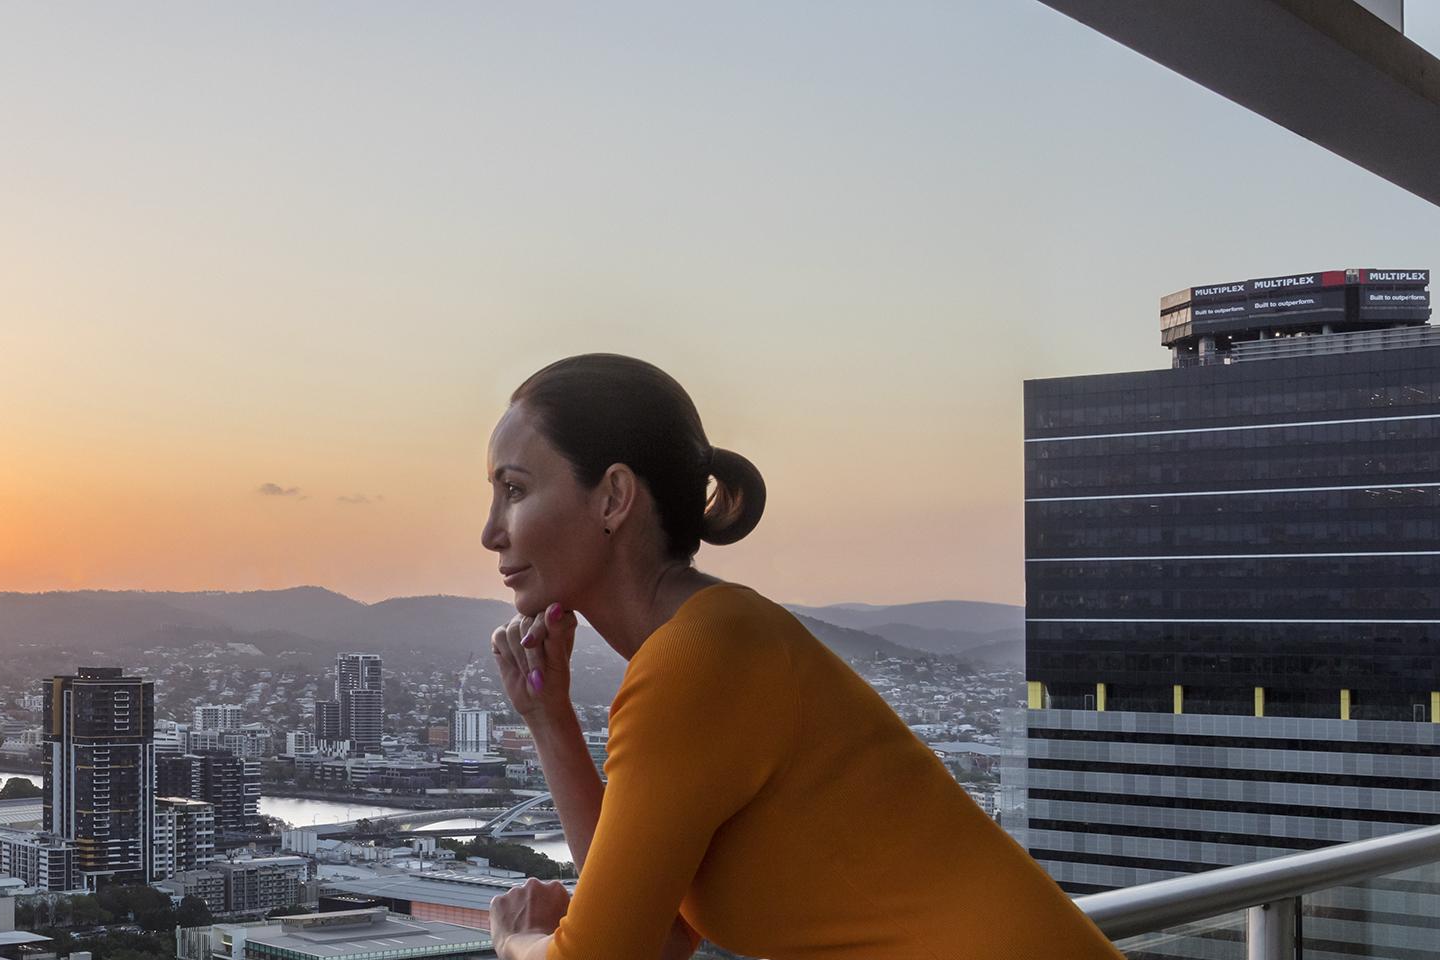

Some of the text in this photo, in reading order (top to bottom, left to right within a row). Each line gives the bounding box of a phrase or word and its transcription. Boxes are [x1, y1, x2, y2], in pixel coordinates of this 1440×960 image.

[1369, 272, 1425, 280] MULTIPLEX
[1254, 276, 1314, 289] MULTIPLEX
[1195, 285, 1244, 296] MULTIPLEX
